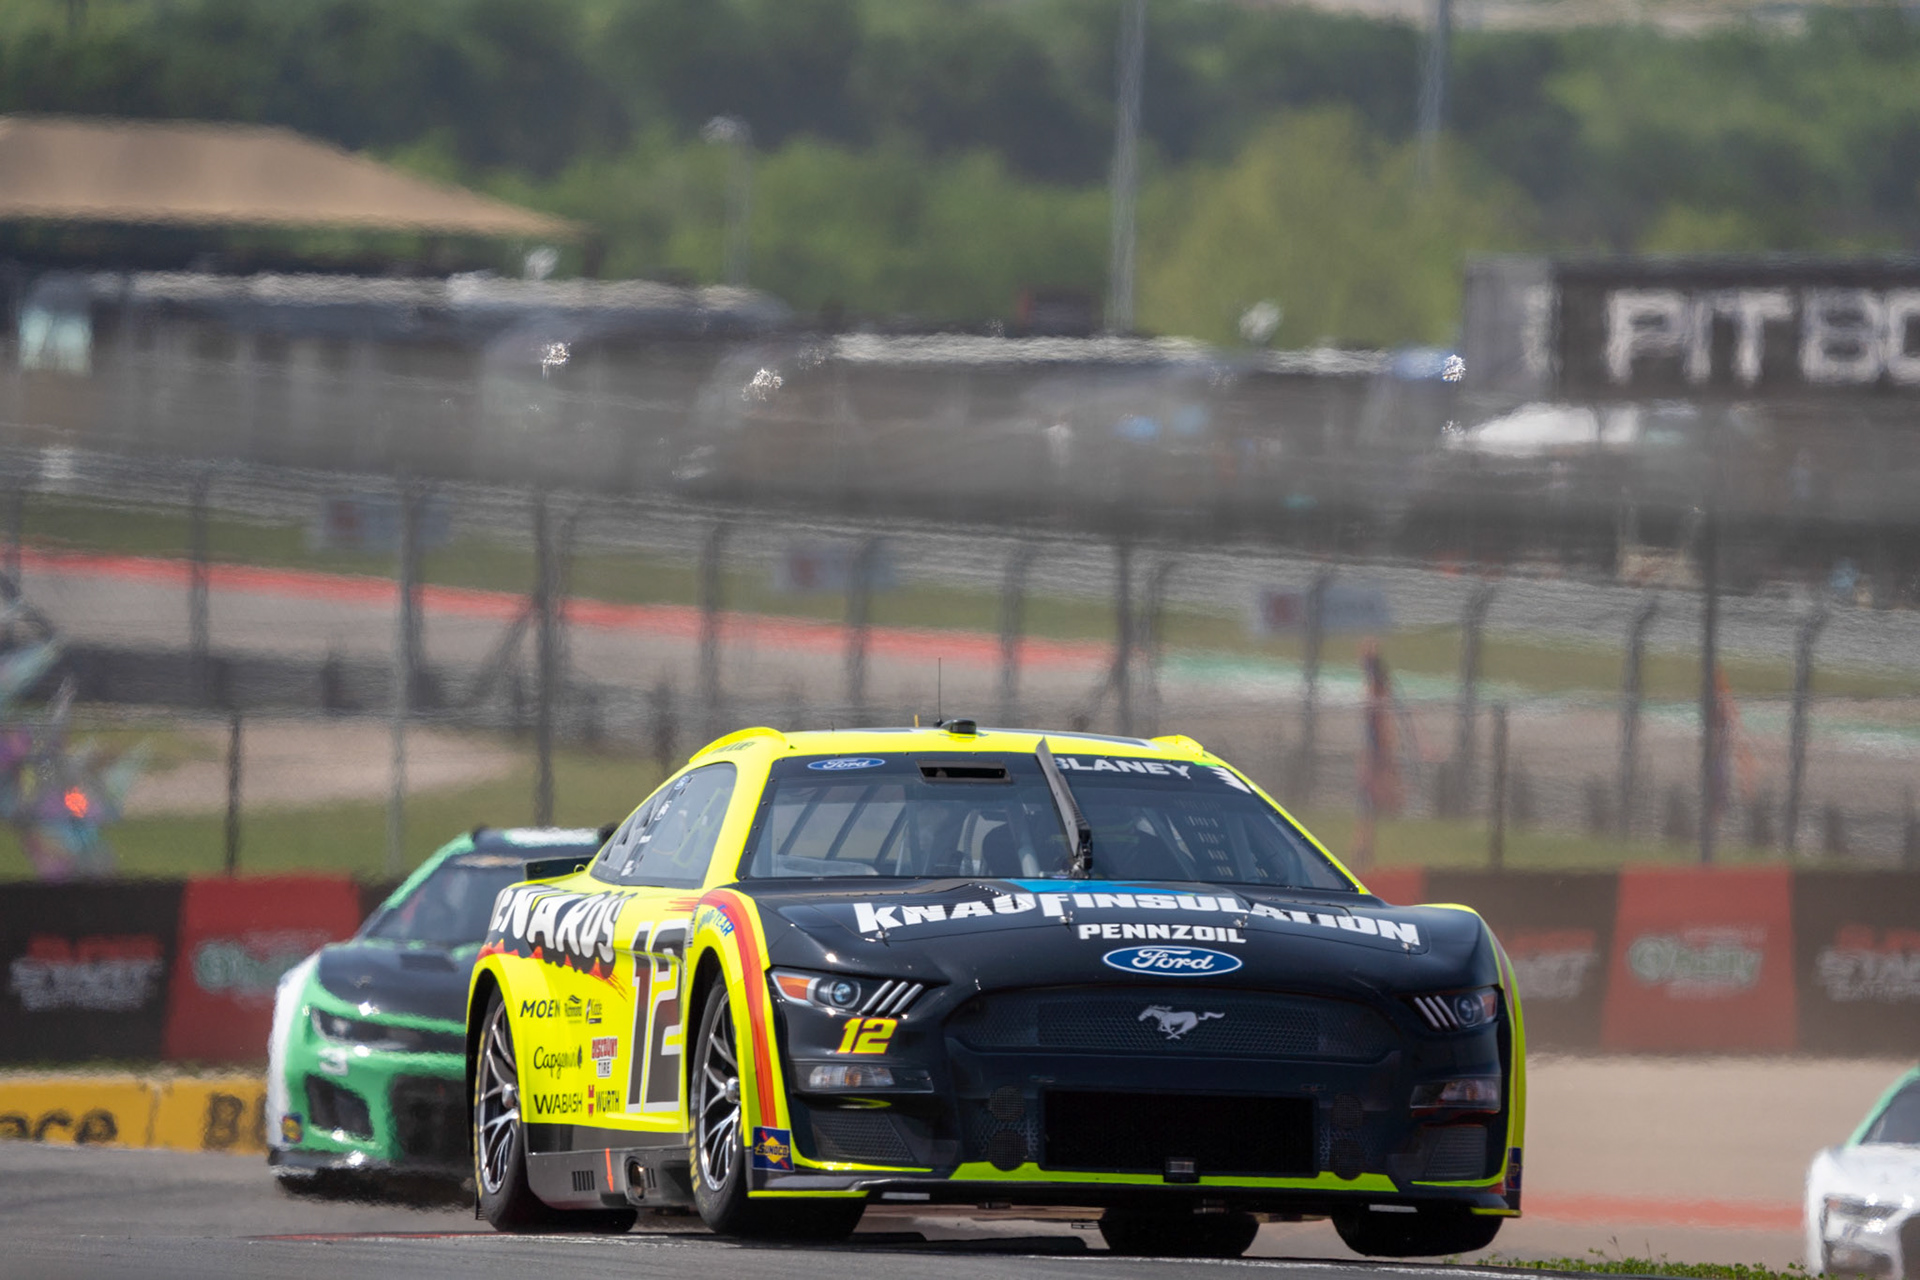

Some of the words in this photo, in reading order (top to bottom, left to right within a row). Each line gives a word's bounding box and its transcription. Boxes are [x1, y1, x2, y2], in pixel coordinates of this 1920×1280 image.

[823, 758, 869, 769] Ford
[853, 893, 1068, 933] KNAUF
[1078, 923, 1247, 944] PENNZOIL
[1131, 948, 1218, 971] Ford
[520, 1000, 560, 1018] MOEN
[626, 919, 686, 1114] 12
[836, 1017, 898, 1055] 12
[534, 1094, 583, 1114] WABASH
[757, 1142, 789, 1158] SUNOCO
